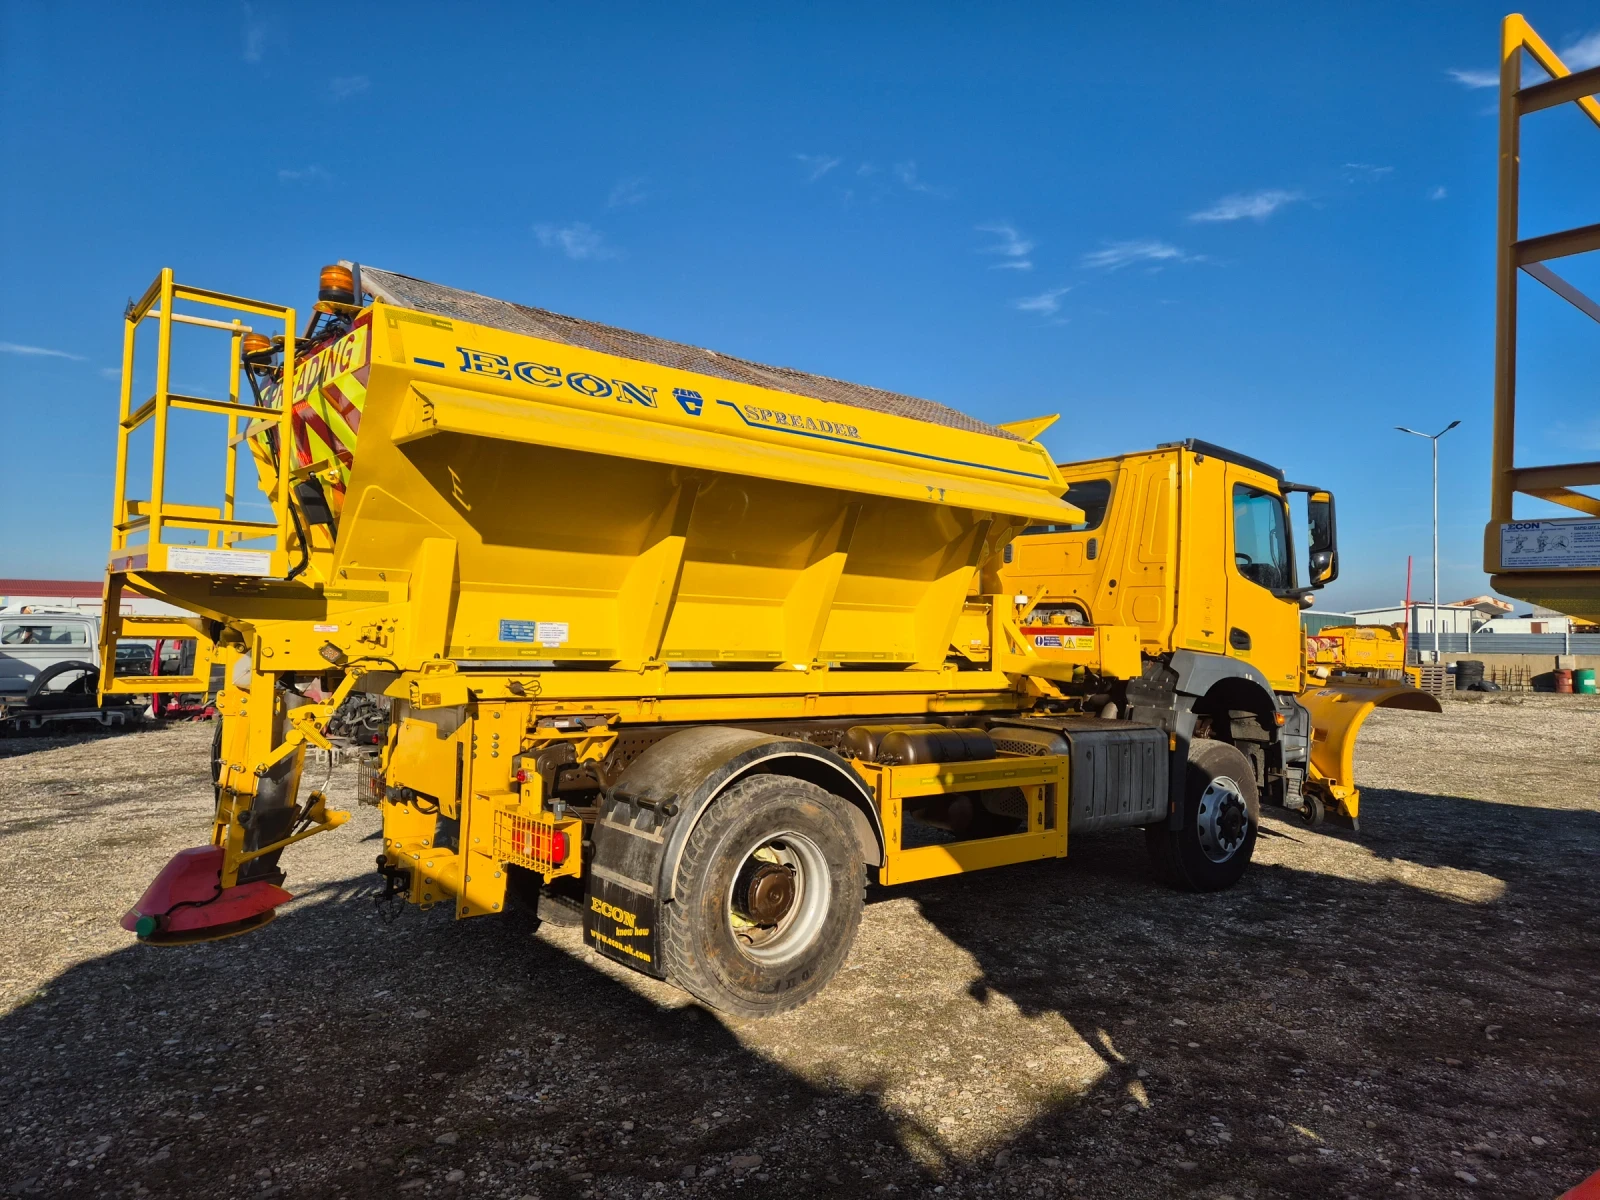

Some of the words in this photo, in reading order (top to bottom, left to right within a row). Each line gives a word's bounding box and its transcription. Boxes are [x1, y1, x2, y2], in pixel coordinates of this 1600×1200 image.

[259, 334, 355, 410] SPRADING
[456, 346, 659, 408] ECON
[744, 404, 861, 439] SPREADER
[1508, 522, 1540, 530] ECON
[591, 896, 636, 928] ECON
[590, 929, 651, 962] www.econ.uk.com
[616, 926, 633, 936] know
[634, 926, 649, 936] how
